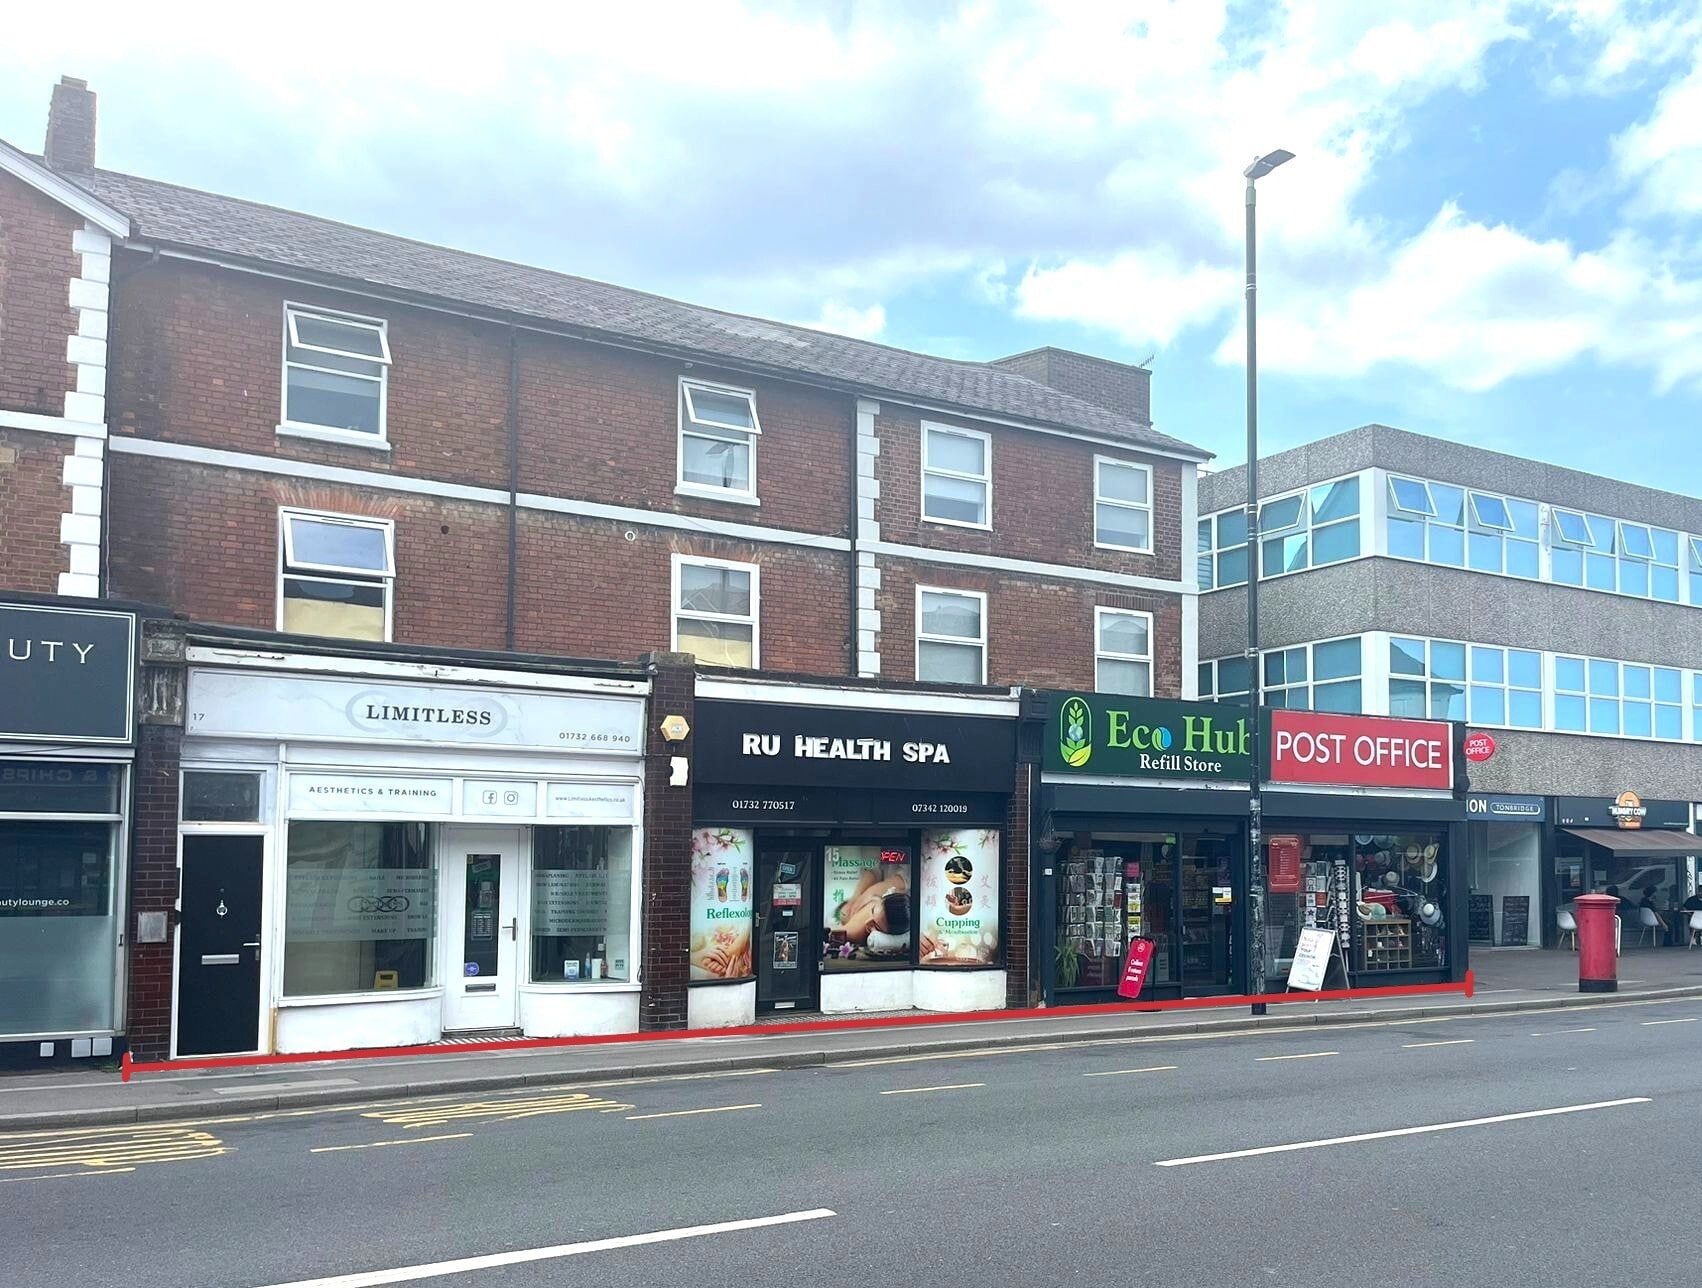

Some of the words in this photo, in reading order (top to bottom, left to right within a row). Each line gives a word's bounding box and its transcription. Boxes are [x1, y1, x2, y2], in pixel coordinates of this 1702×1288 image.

[9, 638, 94, 664] UTY
[193, 712, 205, 721] 17
[366, 704, 491, 726] LIMITLESS
[1106, 710, 1172, 751] Eco
[559, 732, 587, 741] 01732
[590, 733, 609, 742] 668
[612, 734, 631, 743] 940
[1469, 738, 1488, 747] POST
[742, 733, 781, 756] RU
[794, 735, 891, 761] HEALTH
[902, 741, 950, 763] SPA
[1276, 731, 1347, 764] POST
[1354, 735, 1442, 769] OFFICE
[1465, 746, 1491, 755] OFFICE
[1139, 753, 1181, 771] Refill
[1184, 755, 1222, 773] Store
[309, 786, 374, 795] AESTHETICS
[388, 788, 437, 797] TRAINING
[732, 800, 760, 809] 01732
[762, 800, 795, 810] 770517
[912, 804, 937, 813] 07342
[940, 804, 968, 813] 120019
[1495, 804, 1534, 812] TONBRIDGE
[0, 898, 70, 907] utylounge.co
[935, 917, 981, 929] Cupping
